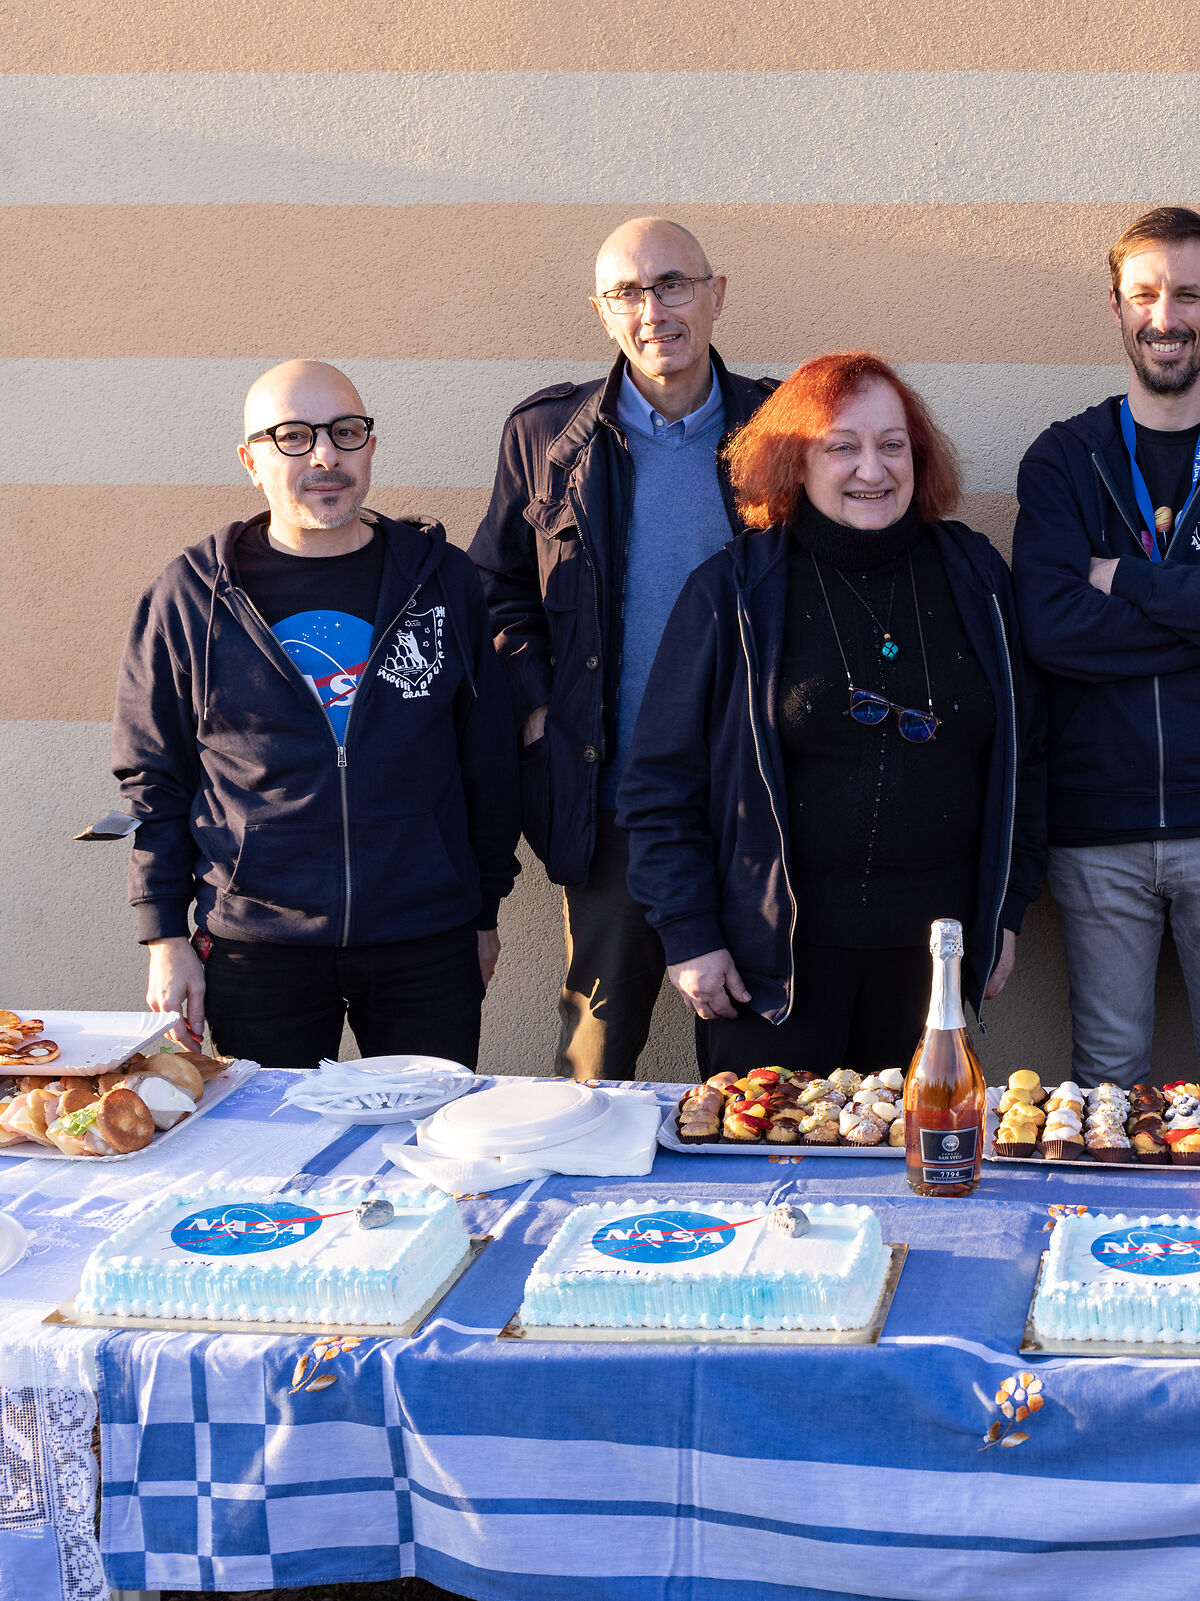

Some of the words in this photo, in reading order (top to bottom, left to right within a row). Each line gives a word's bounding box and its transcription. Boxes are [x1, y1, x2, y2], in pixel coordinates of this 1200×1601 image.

[376, 668, 411, 692] strofili
[184, 1218, 306, 1236] NASA
[604, 1228, 725, 1244] NASA
